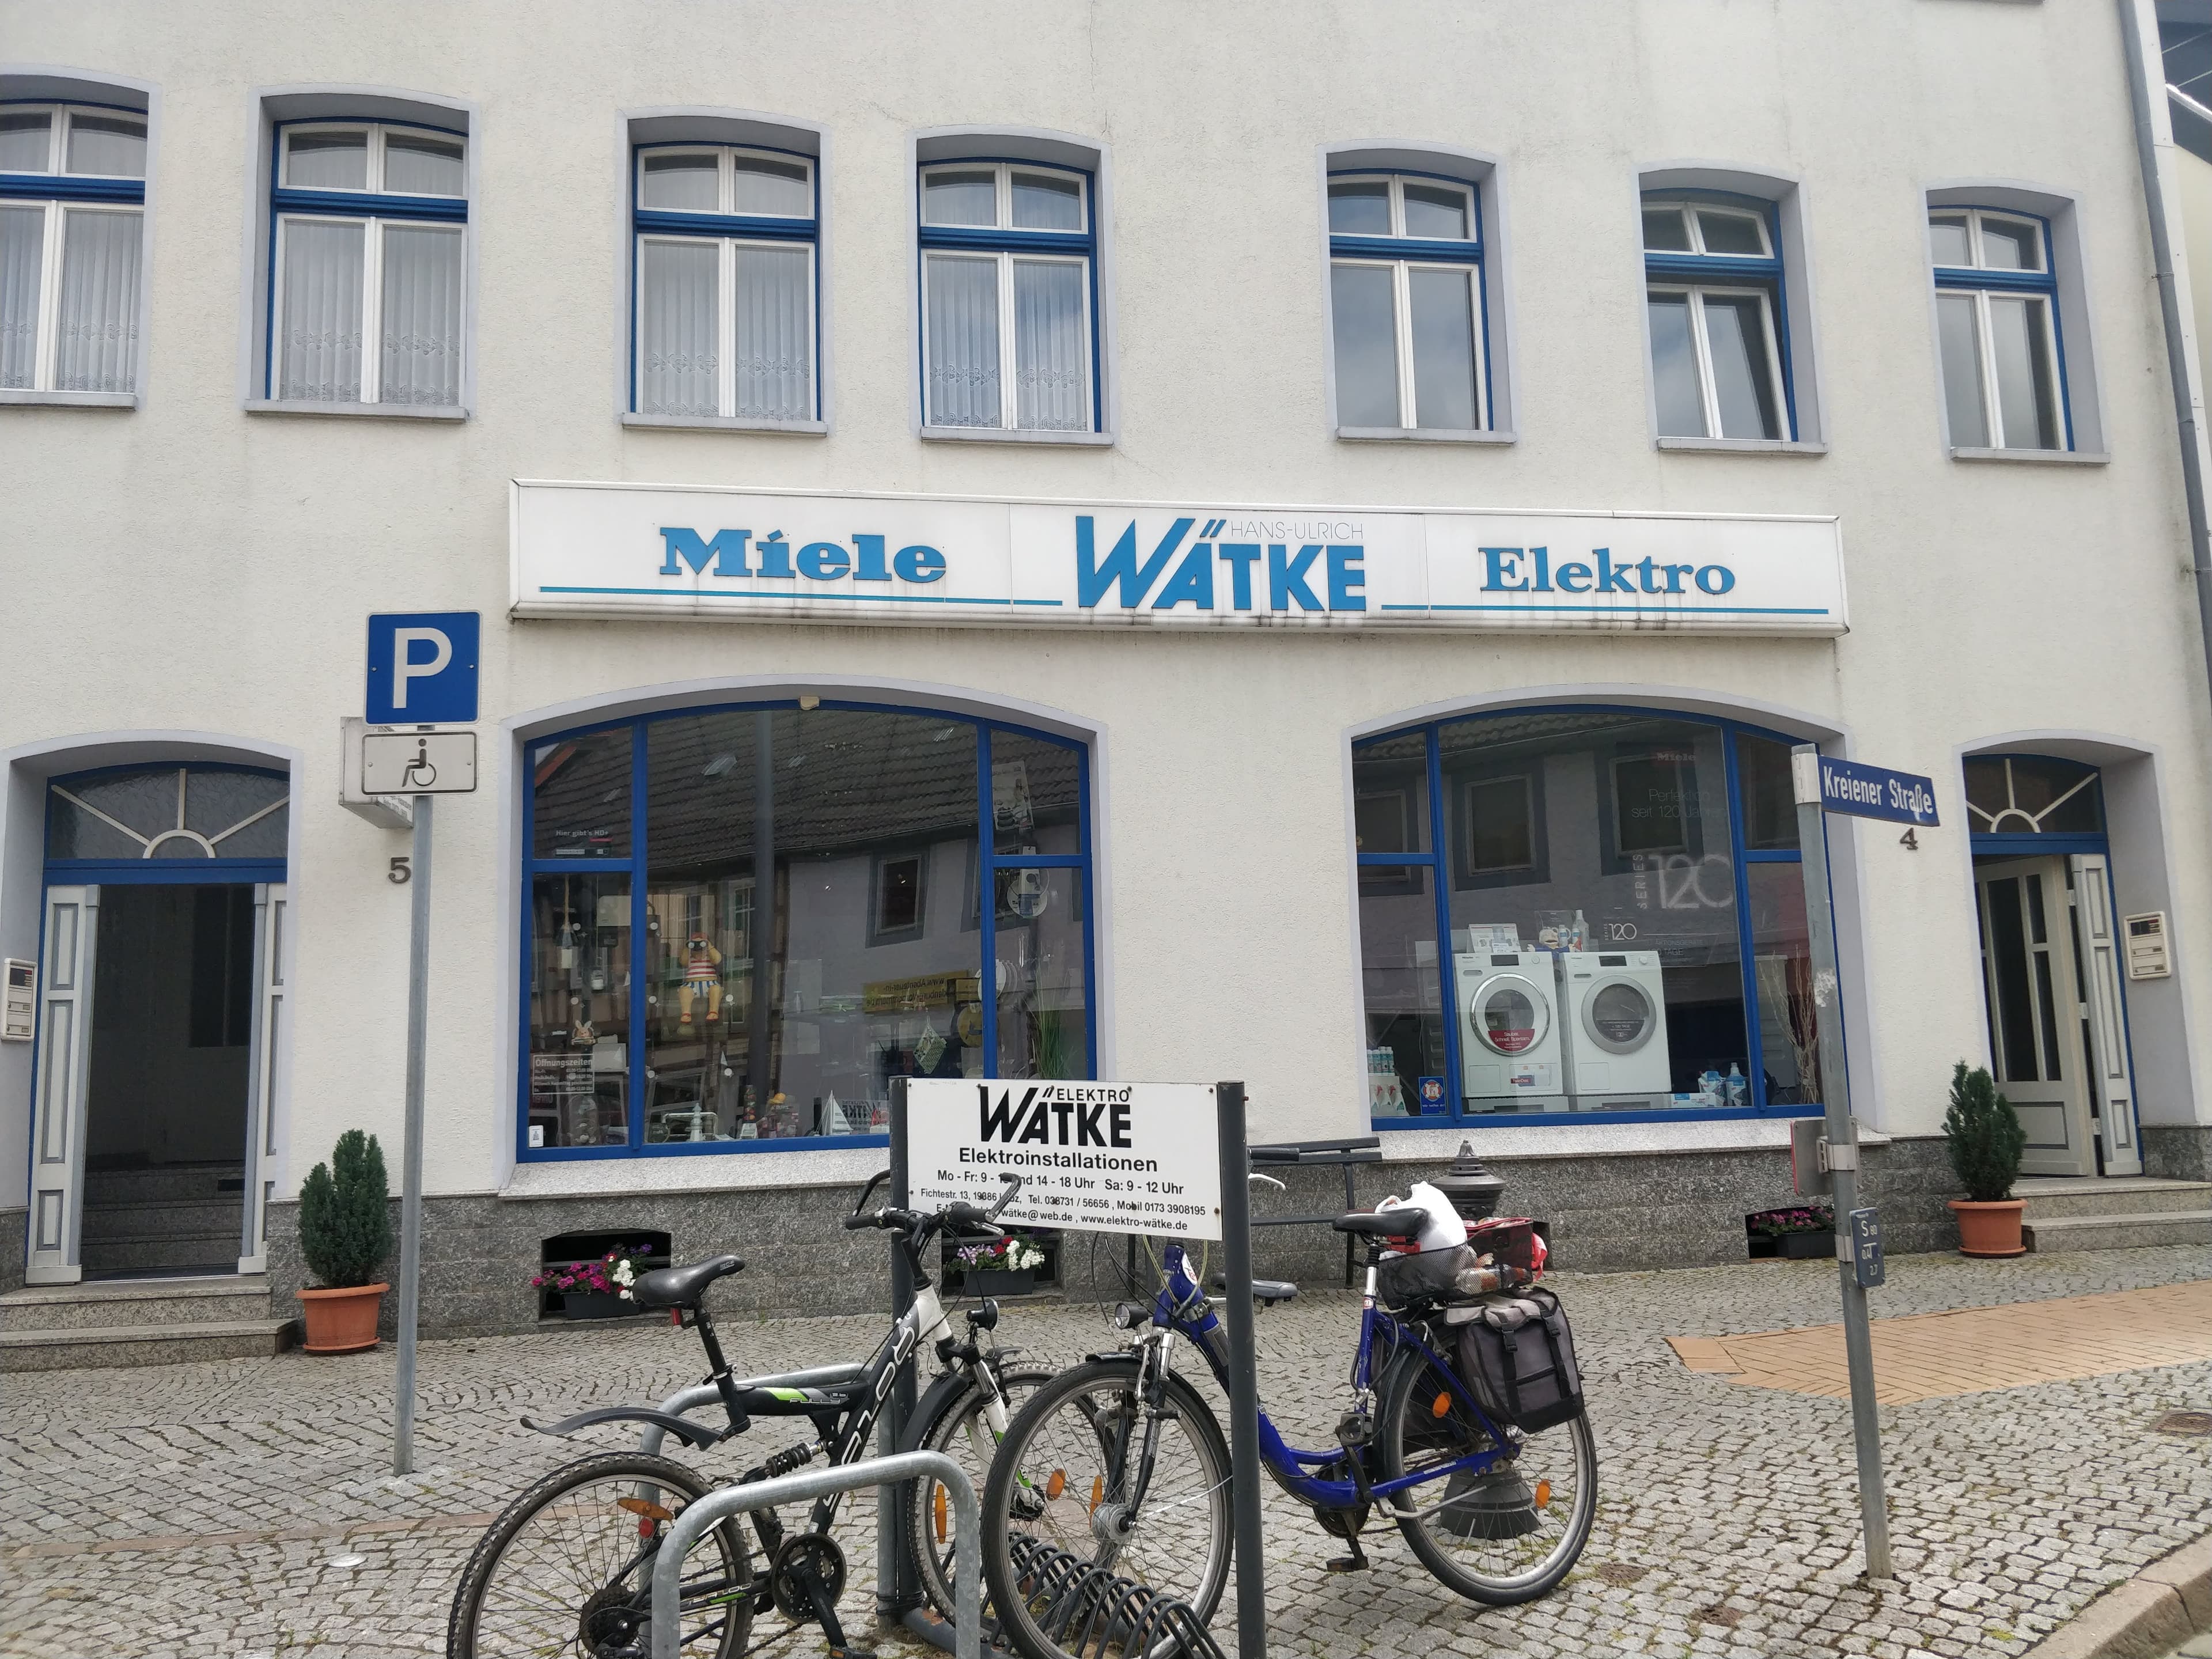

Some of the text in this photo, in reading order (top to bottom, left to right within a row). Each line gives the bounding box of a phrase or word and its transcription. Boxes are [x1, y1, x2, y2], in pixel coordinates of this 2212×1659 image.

[1230, 521, 1363, 541] HANS-ULRICH
[660, 527, 946, 583] Miele
[1075, 516, 1365, 611] WÄTKE
[1478, 546, 1736, 594] Elektro
[393, 627, 452, 709] P
[1656, 753, 1696, 761] Miele
[1823, 766, 1933, 814] Kreiener Straße
[1631, 806, 1653, 818] seit
[1659, 805, 1681, 818] 120
[1900, 827, 1918, 850] 4
[388, 857, 412, 884] 5
[1633, 854, 1733, 909] SERIES 120
[1608, 923, 1637, 940] 120
[1057, 1088, 1130, 1102] ELEKTRO
[980, 1086, 1132, 1148] WÄTKE
[959, 1147, 1158, 1172] Elektroinstallationen
[938, 1170, 954, 1181] Mo
[964, 1171, 978, 1182] Fr:
[980, 1172, 987, 1183] 9
[1036, 1175, 1048, 1186] 14
[1059, 1177, 1071, 1187] 18
[1075, 1177, 1094, 1188] Uhr
[1105, 1179, 1123, 1191] Sa:
[1127, 1180, 1134, 1191] 9
[1146, 1181, 1158, 1193] 12
[1162, 1182, 1184, 1194] Uhr
[921, 1188, 957, 1199] Fichtestr.
[960, 1190, 971, 1201] 13,
[1028, 1194, 1043, 1205] Tel.
[1044, 1195, 1074, 1206] 038731
[1082, 1198, 1109, 1209] 56656
[1117, 1200, 1142, 1211] Mobil
[1145, 1202, 1165, 1213] 0173
[1167, 1204, 1206, 1215] 3908195
[1081, 1215, 1188, 1230] www.elektro-wätke.de
[1861, 1220, 1869, 1237] S
